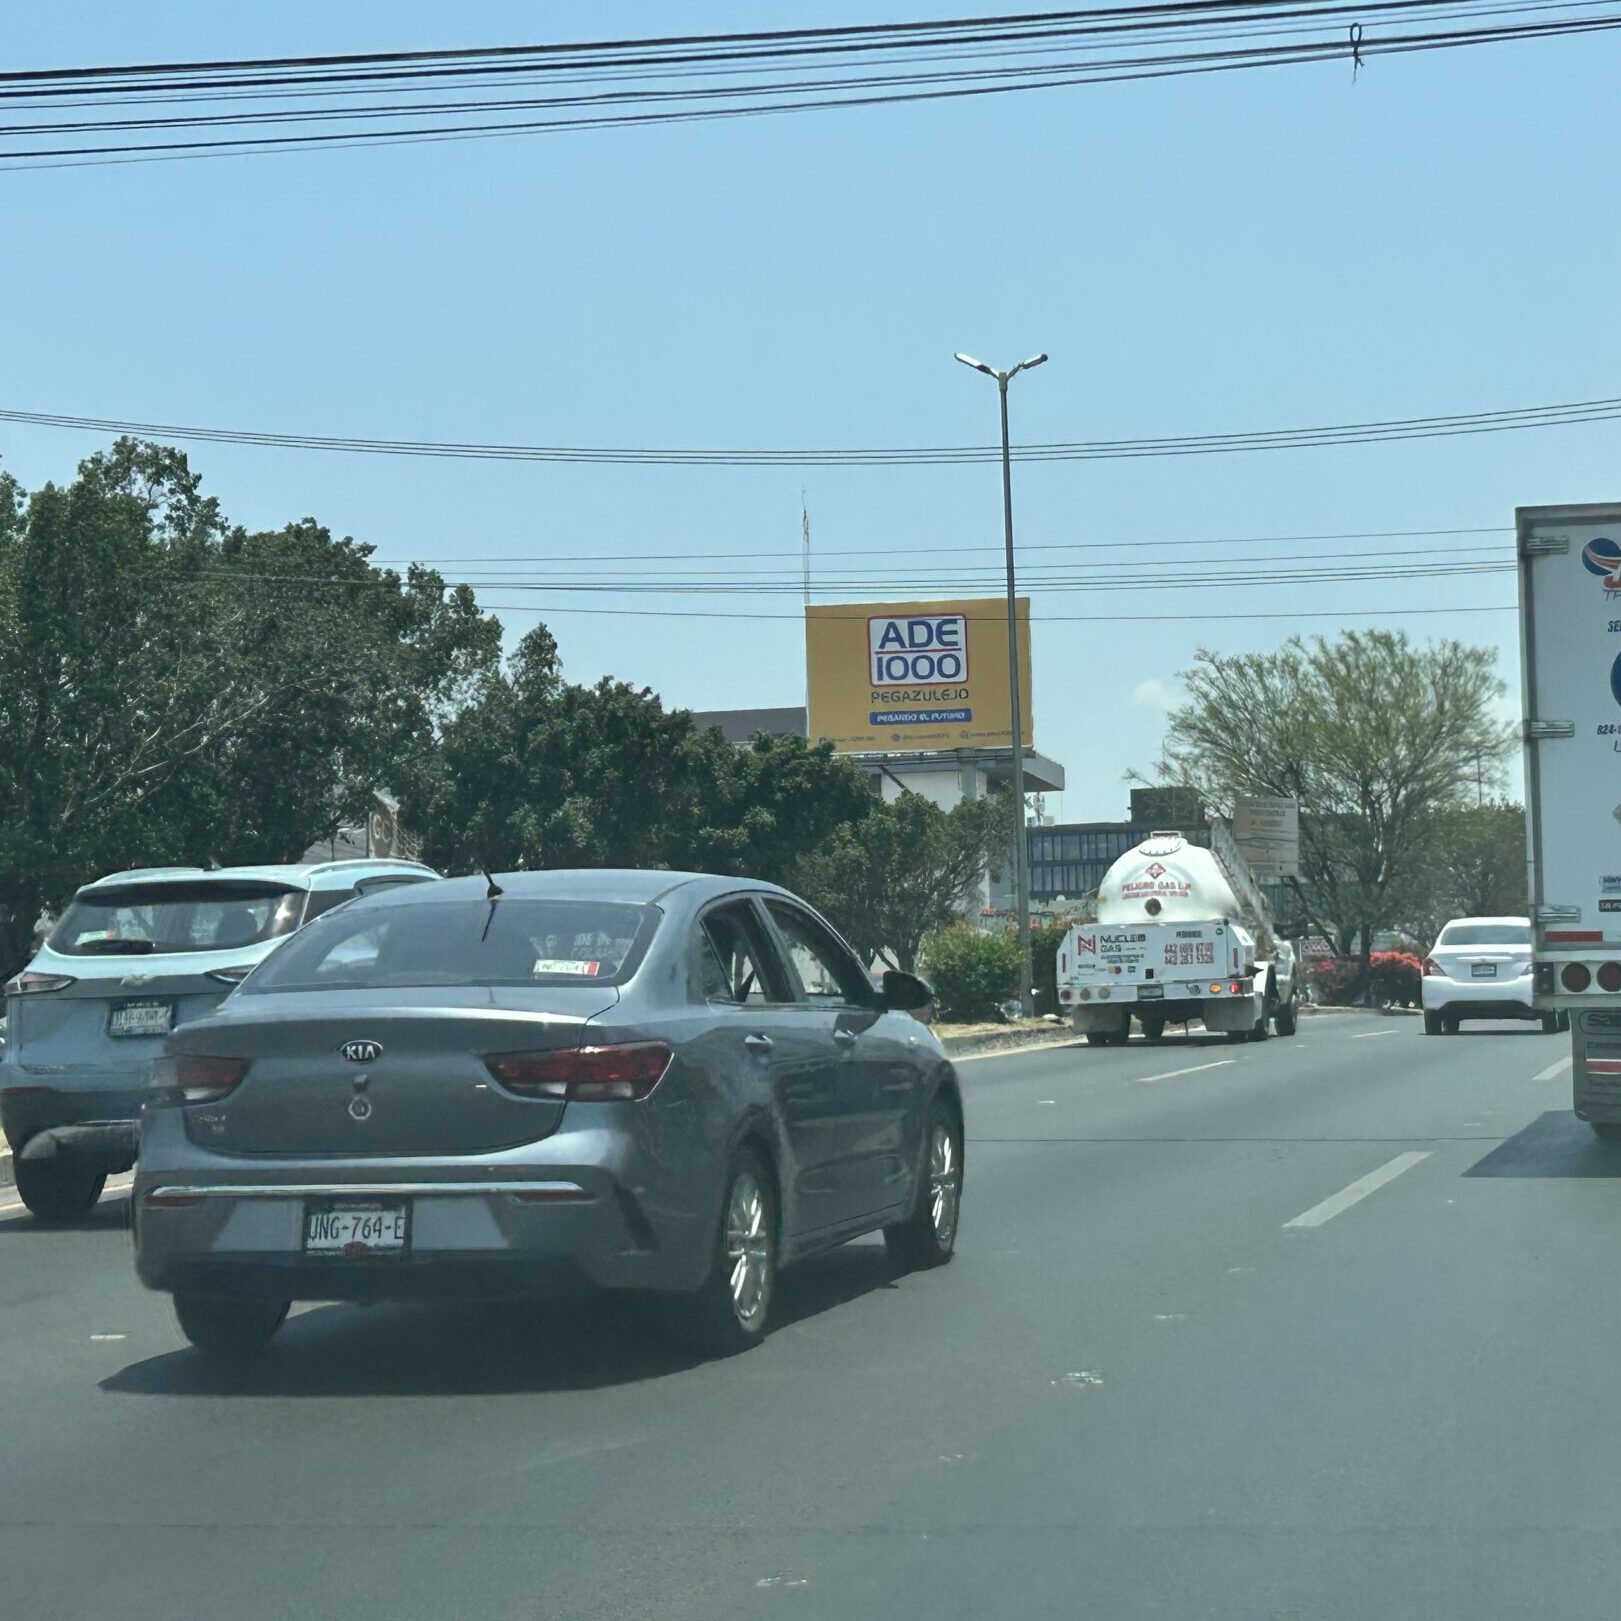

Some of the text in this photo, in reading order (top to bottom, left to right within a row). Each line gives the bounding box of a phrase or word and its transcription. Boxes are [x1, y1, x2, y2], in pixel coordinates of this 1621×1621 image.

[878, 618, 959, 649] ADE
[1607, 620, 1621, 633] SE
[876, 653, 961, 681] 1000
[871, 688, 969, 704] PEGAZULEJO
[346, 1045, 376, 1060] KIA
